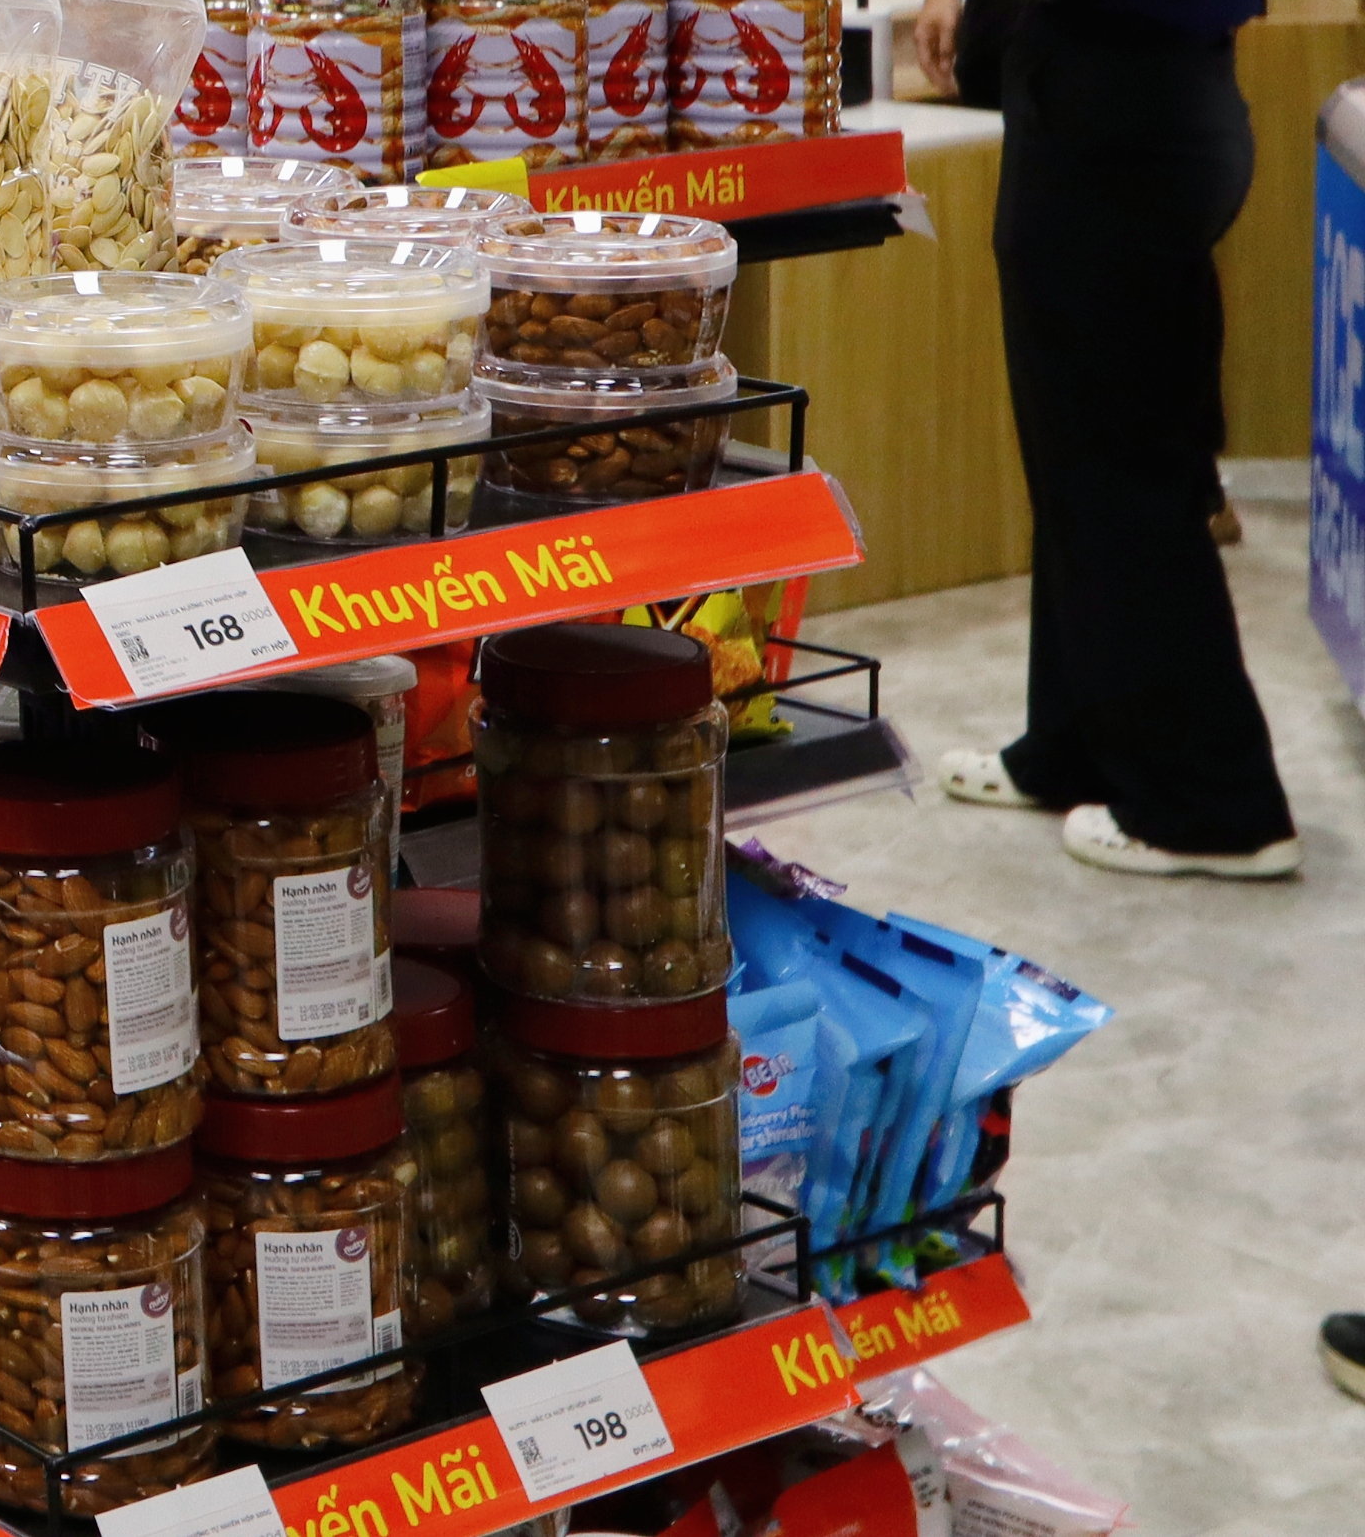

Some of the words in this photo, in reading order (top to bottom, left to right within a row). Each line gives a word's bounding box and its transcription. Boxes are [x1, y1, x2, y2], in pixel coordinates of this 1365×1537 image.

[545, 169, 676, 213] Khuyến
[686, 162, 746, 209] Mãi
[288, 553, 504, 639] Khuyến
[505, 533, 614, 599] Mãi
[182, 613, 245, 651] 168
[281, 884, 311, 898] Hạnh
[312, 882, 337, 895] nhân
[744, 1052, 798, 1090] BEAR
[263, 1242, 293, 1255] Hạnh
[295, 1242, 324, 1254] nhân
[69, 1302, 99, 1315] Hạnh
[101, 1300, 129, 1311] nhân
[893, 1290, 963, 1345] Mãi
[573, 1411, 628, 1452] 198
[389, 1444, 498, 1516] Mãi
